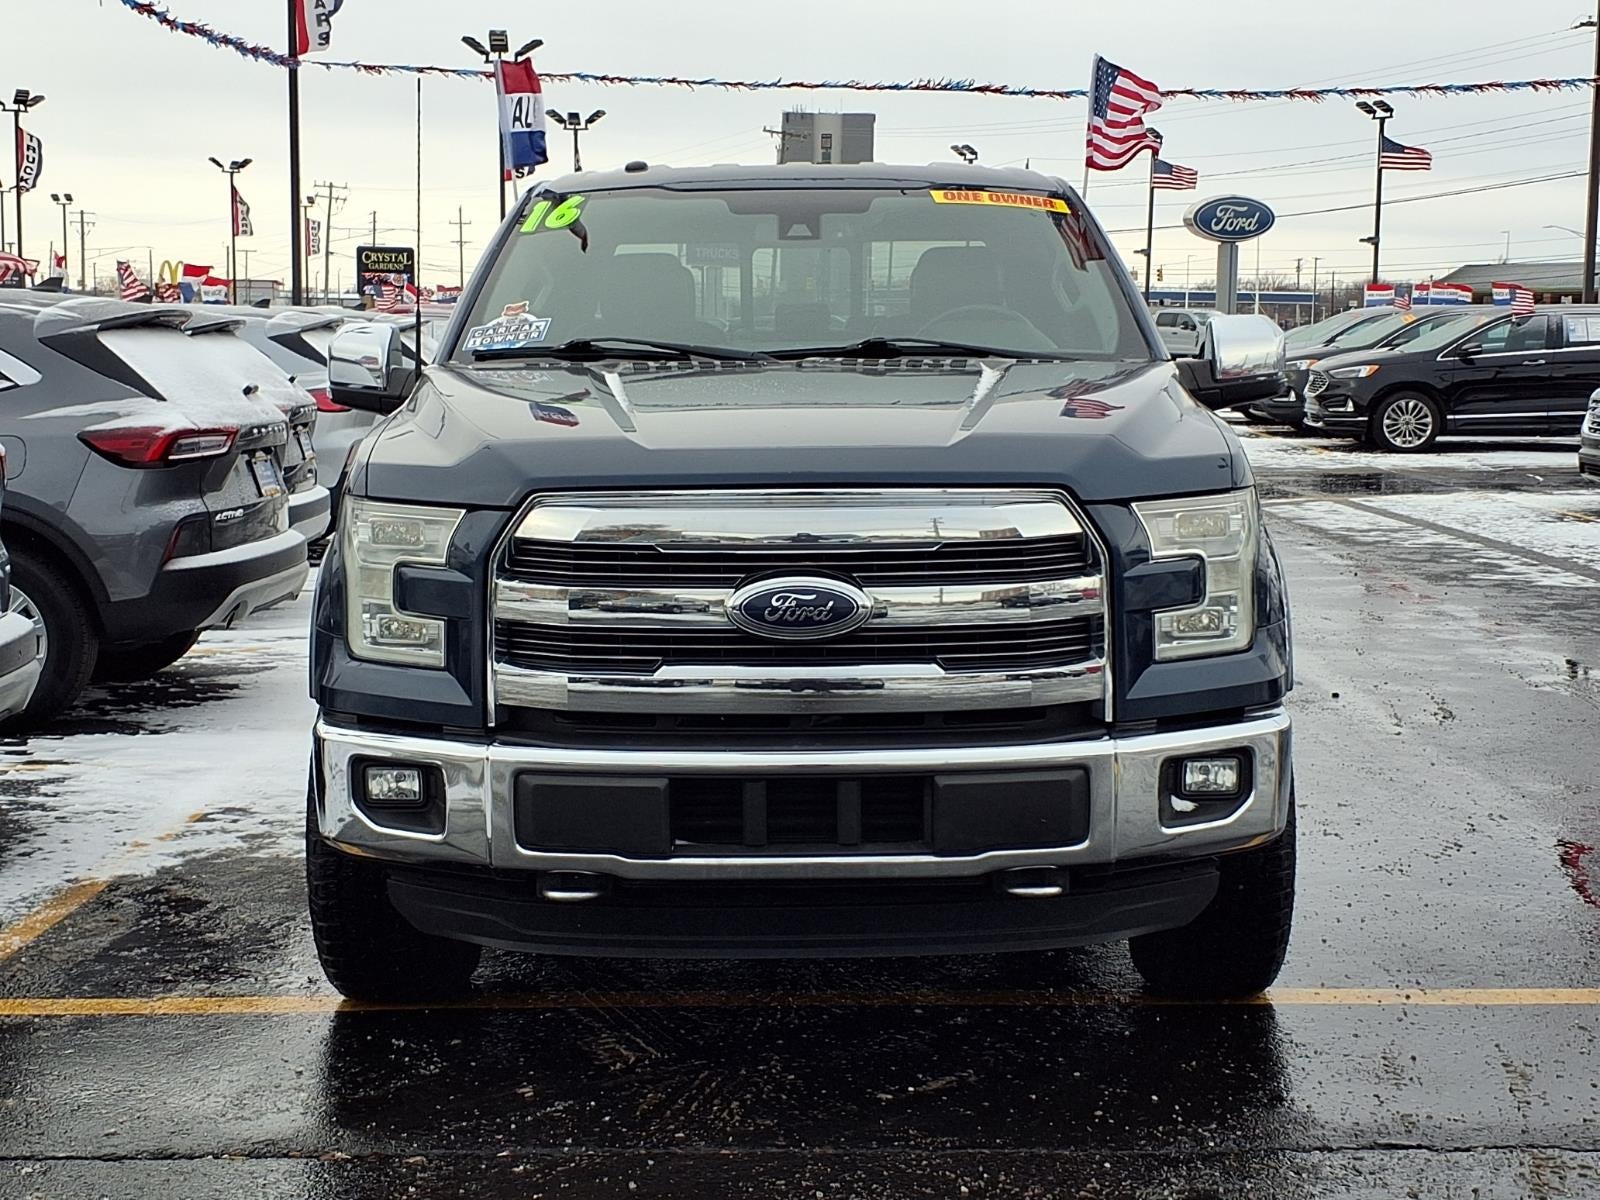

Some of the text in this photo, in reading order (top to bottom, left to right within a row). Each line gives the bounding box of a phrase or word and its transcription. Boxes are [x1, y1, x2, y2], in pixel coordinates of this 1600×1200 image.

[943, 191, 1055, 209] ONE OWNER
[520, 195, 586, 233] 16
[1211, 205, 1260, 232] Ford
[362, 251, 411, 265] CRYSTAL
[368, 262, 404, 271] GARDENS
[482, 331, 540, 345] OWNER
[764, 593, 834, 621] Ford
